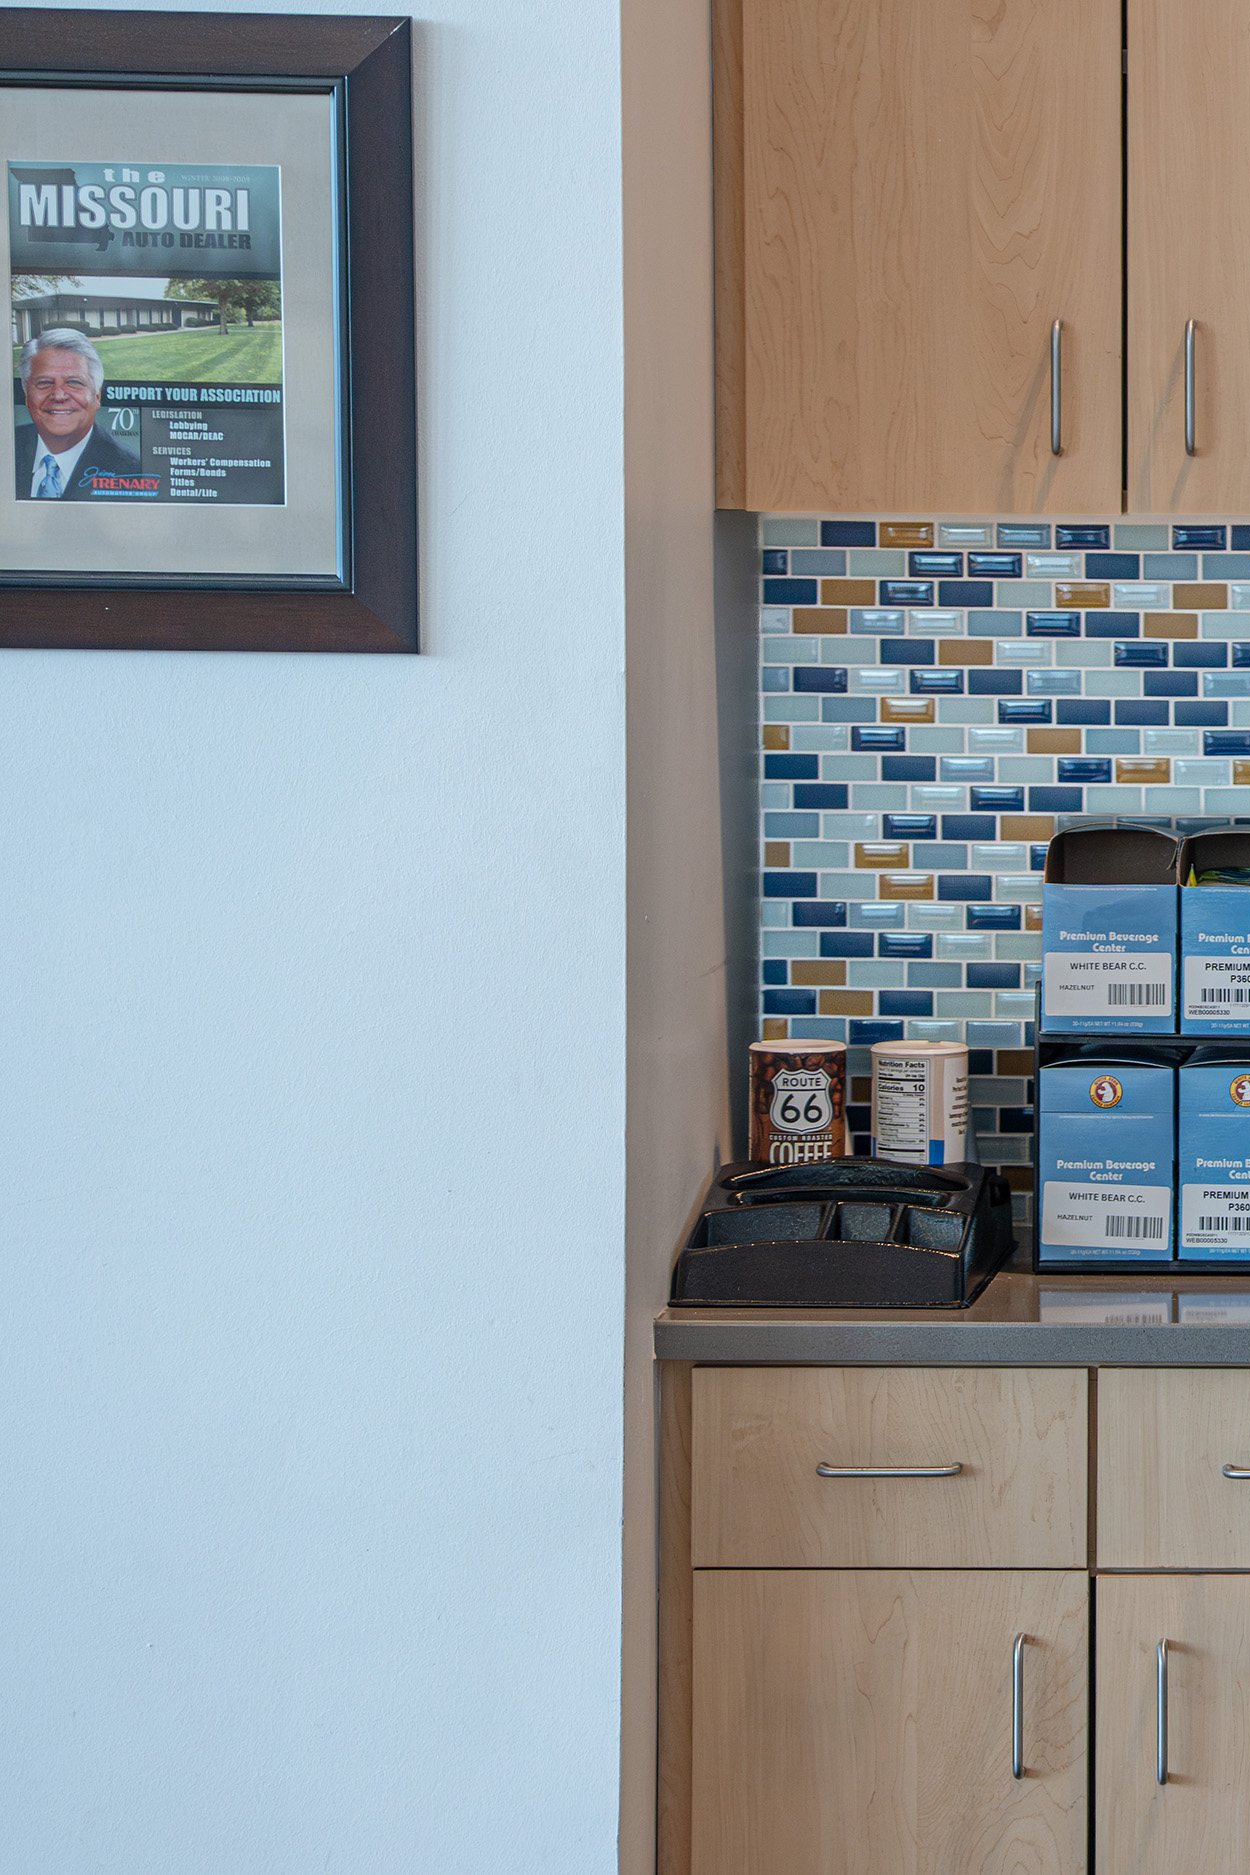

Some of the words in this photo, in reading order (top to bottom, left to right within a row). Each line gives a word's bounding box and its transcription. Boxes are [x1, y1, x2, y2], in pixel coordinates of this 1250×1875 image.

[104, 168, 166, 183] the
[19, 184, 249, 231] MISSOURI
[122, 231, 174, 248] AUTO
[180, 232, 252, 250] DEALER
[106, 386, 162, 401] SUPPORT
[165, 387, 198, 402] YOUR
[200, 388, 281, 403] ASSOCIATION
[152, 410, 202, 420] LEGISLATION
[169, 420, 208, 432] Lobbying
[152, 446, 192, 456] SERVICES
[170, 457, 208, 468] Workers'
[209, 458, 271, 468] Compensation
[170, 467, 226, 477] Forms/Bonds
[92, 477, 161, 491] TRENARY
[170, 477, 195, 487] Titles
[170, 488, 218, 498] Dental/Life
[1060, 931, 1106, 941] Premium
[1109, 932, 1159, 943] Beverage
[1198, 933, 1244, 943] Premium
[1092, 943, 1126, 952] Center
[1205, 963, 1250, 971] PREMIUM
[782, 1078, 822, 1087] ROUTE
[878, 1083, 904, 1091] Calories
[913, 1084, 925, 1092] 10
[780, 1093, 823, 1124] 66
[1056, 1160, 1102, 1170] Premium
[1106, 1160, 1156, 1172] Beverage
[1196, 1158, 1242, 1168] Premium
[1089, 1171, 1123, 1181] Center
[1069, 1192, 1099, 1202] WHITE
[1102, 1194, 1126, 1202] BEAR
[1128, 1195, 1145, 1203] C.C.
[1203, 1191, 1249, 1200] PREMIUM
